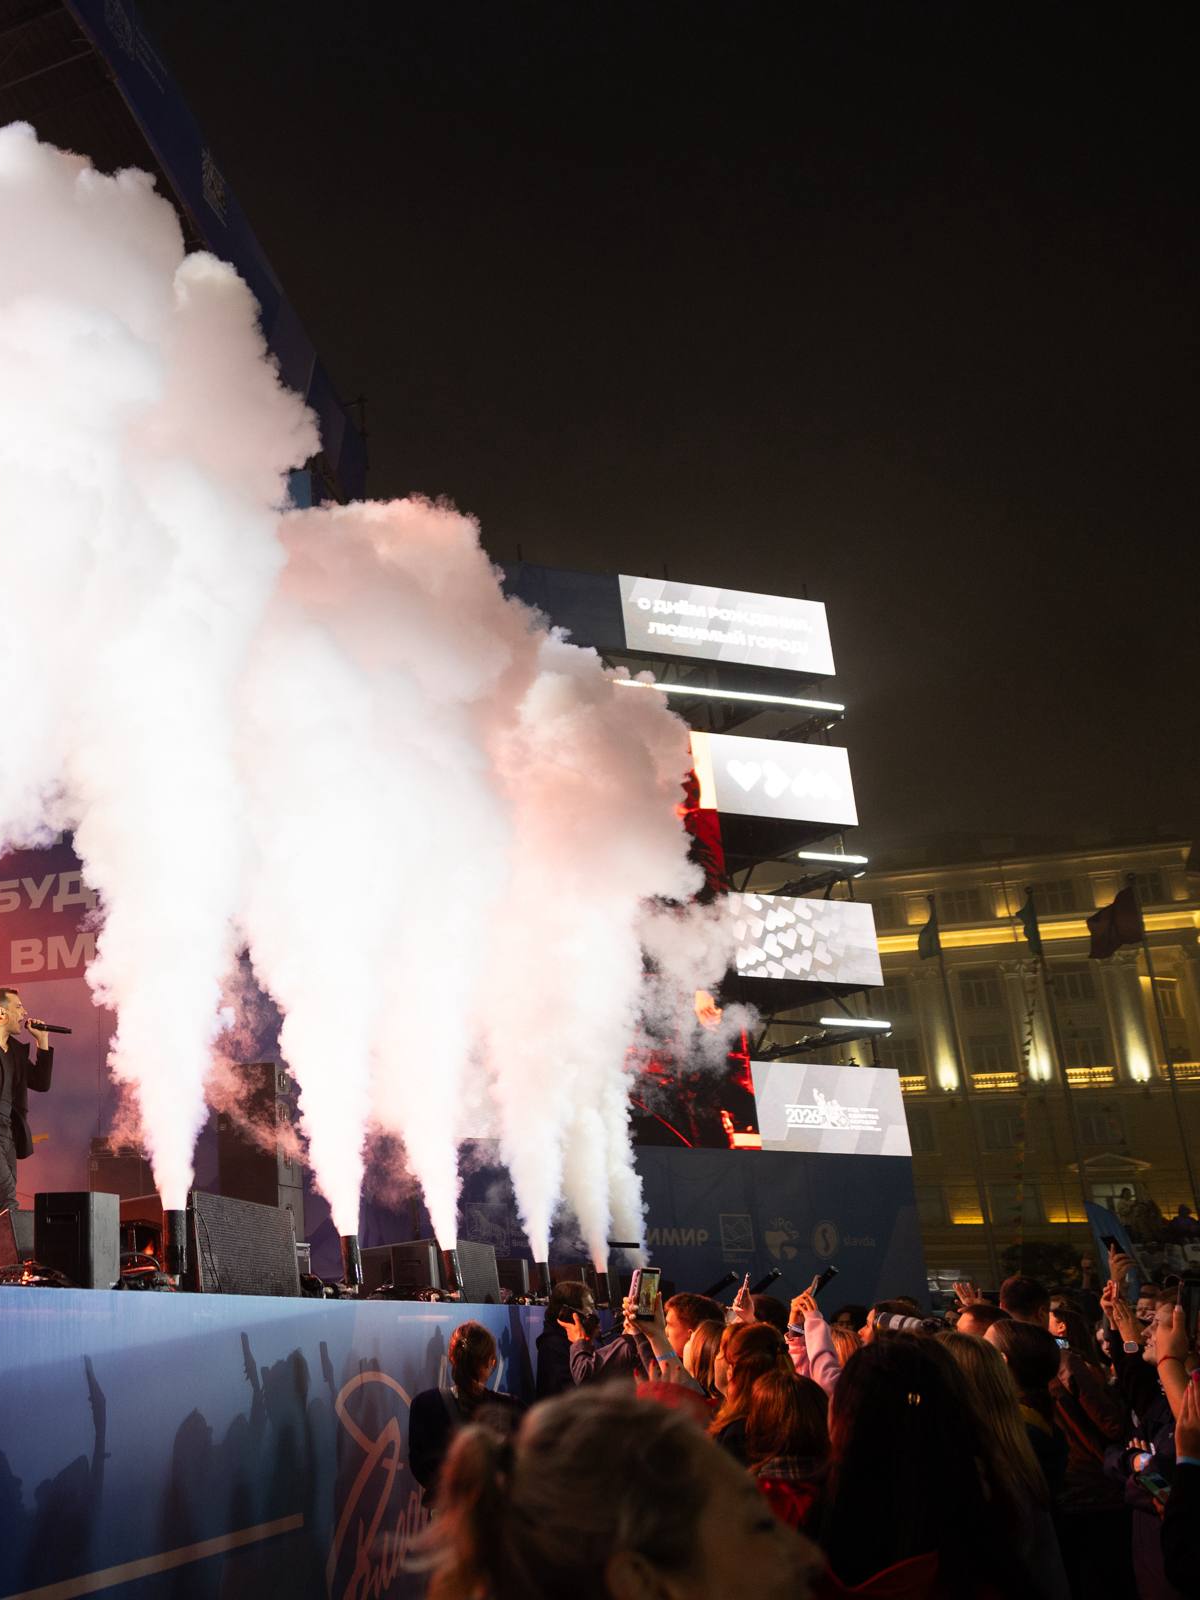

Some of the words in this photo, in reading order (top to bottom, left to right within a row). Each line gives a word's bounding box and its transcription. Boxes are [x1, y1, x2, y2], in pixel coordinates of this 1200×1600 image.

[10, 932, 96, 974] ВМ
[785, 1108, 821, 1124] 2026
[647, 1227, 709, 1246] ИМИР
